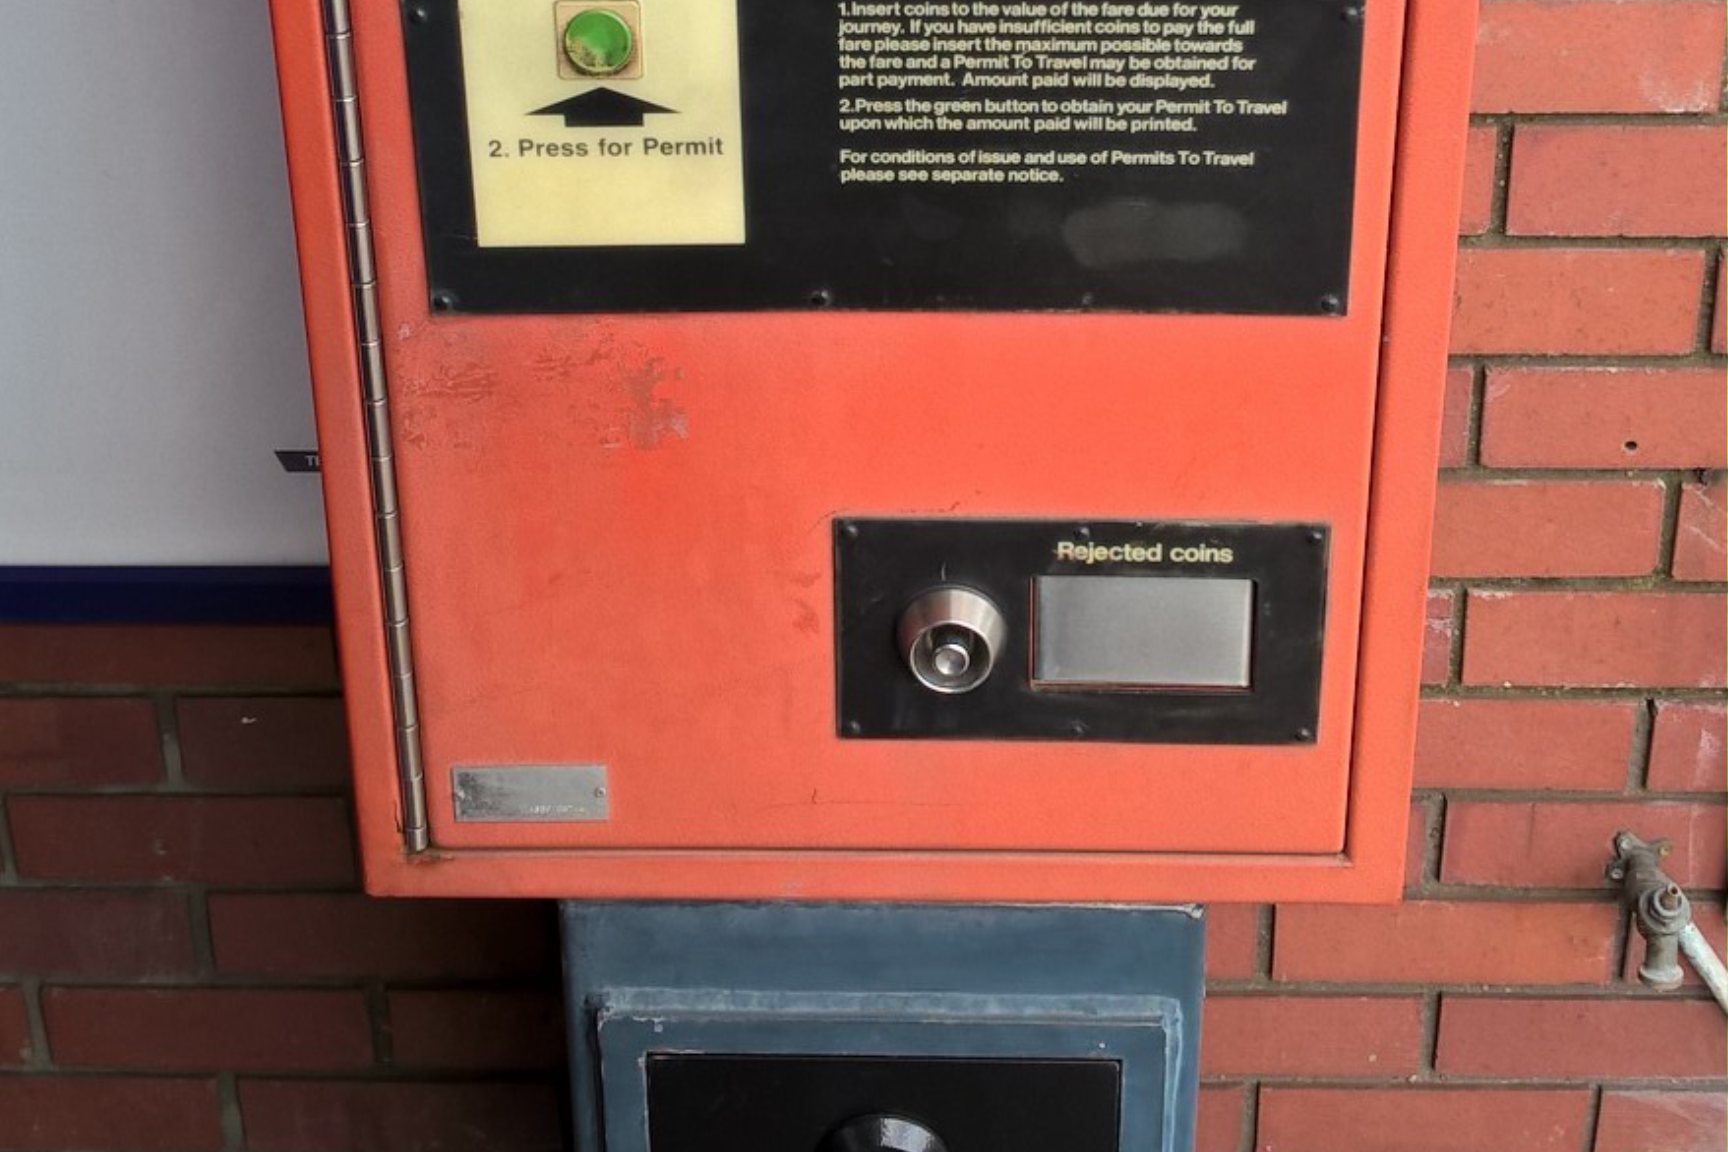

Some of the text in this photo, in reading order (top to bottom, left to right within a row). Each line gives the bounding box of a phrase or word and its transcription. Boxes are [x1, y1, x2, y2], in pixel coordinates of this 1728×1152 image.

[904, 1, 950, 17] coins
[951, 3, 970, 16] to
[972, 2, 1000, 16] the
[1002, 2, 1047, 16] value
[1049, 2, 1069, 16] of
[1070, 2, 1098, 17] the
[1101, 2, 1135, 17] fare
[1137, 2, 1169, 17] due
[1172, 2, 1198, 17] for
[1200, 4, 1240, 20] your
[838, 19, 1256, 37] journey. If you have insufficient coins to pay the full
[838, 54, 1257, 73] the fare and a Permit To Travel may be obtained for
[904, 98, 932, 113] the
[933, 102, 983, 116] green
[984, 98, 1040, 113] button
[1041, 100, 1058, 113] to
[1060, 99, 1114, 114] obtain
[1116, 103, 1152, 116] your
[1155, 99, 1211, 114] Permit
[1213, 100, 1235, 115] To
[1236, 100, 1288, 115] Travel
[488, 136, 724, 158] 2. Press for Permit
[839, 149, 1256, 166] For conditions of issue and use of Permits To Travel
[840, 167, 1064, 185] please see separate notice.
[1056, 541, 1234, 564] Rejected coins
